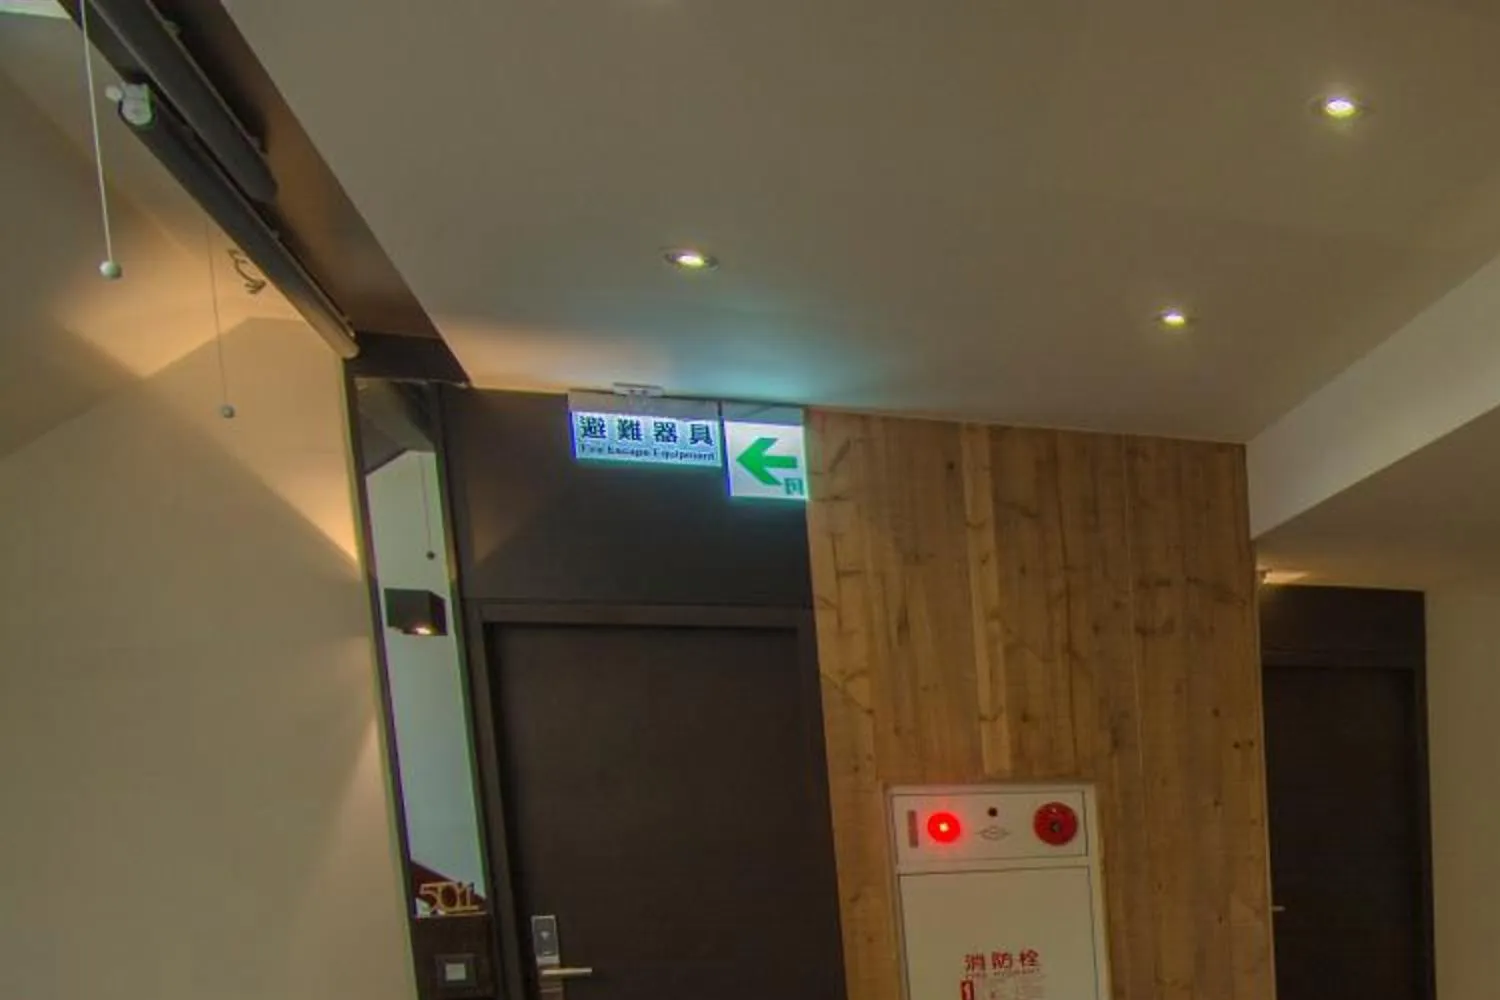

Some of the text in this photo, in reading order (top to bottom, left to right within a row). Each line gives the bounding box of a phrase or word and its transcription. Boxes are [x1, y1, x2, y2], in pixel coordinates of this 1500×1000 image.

[579, 415, 713, 446] 避難器具
[963, 949, 1040, 972] 消防栓
